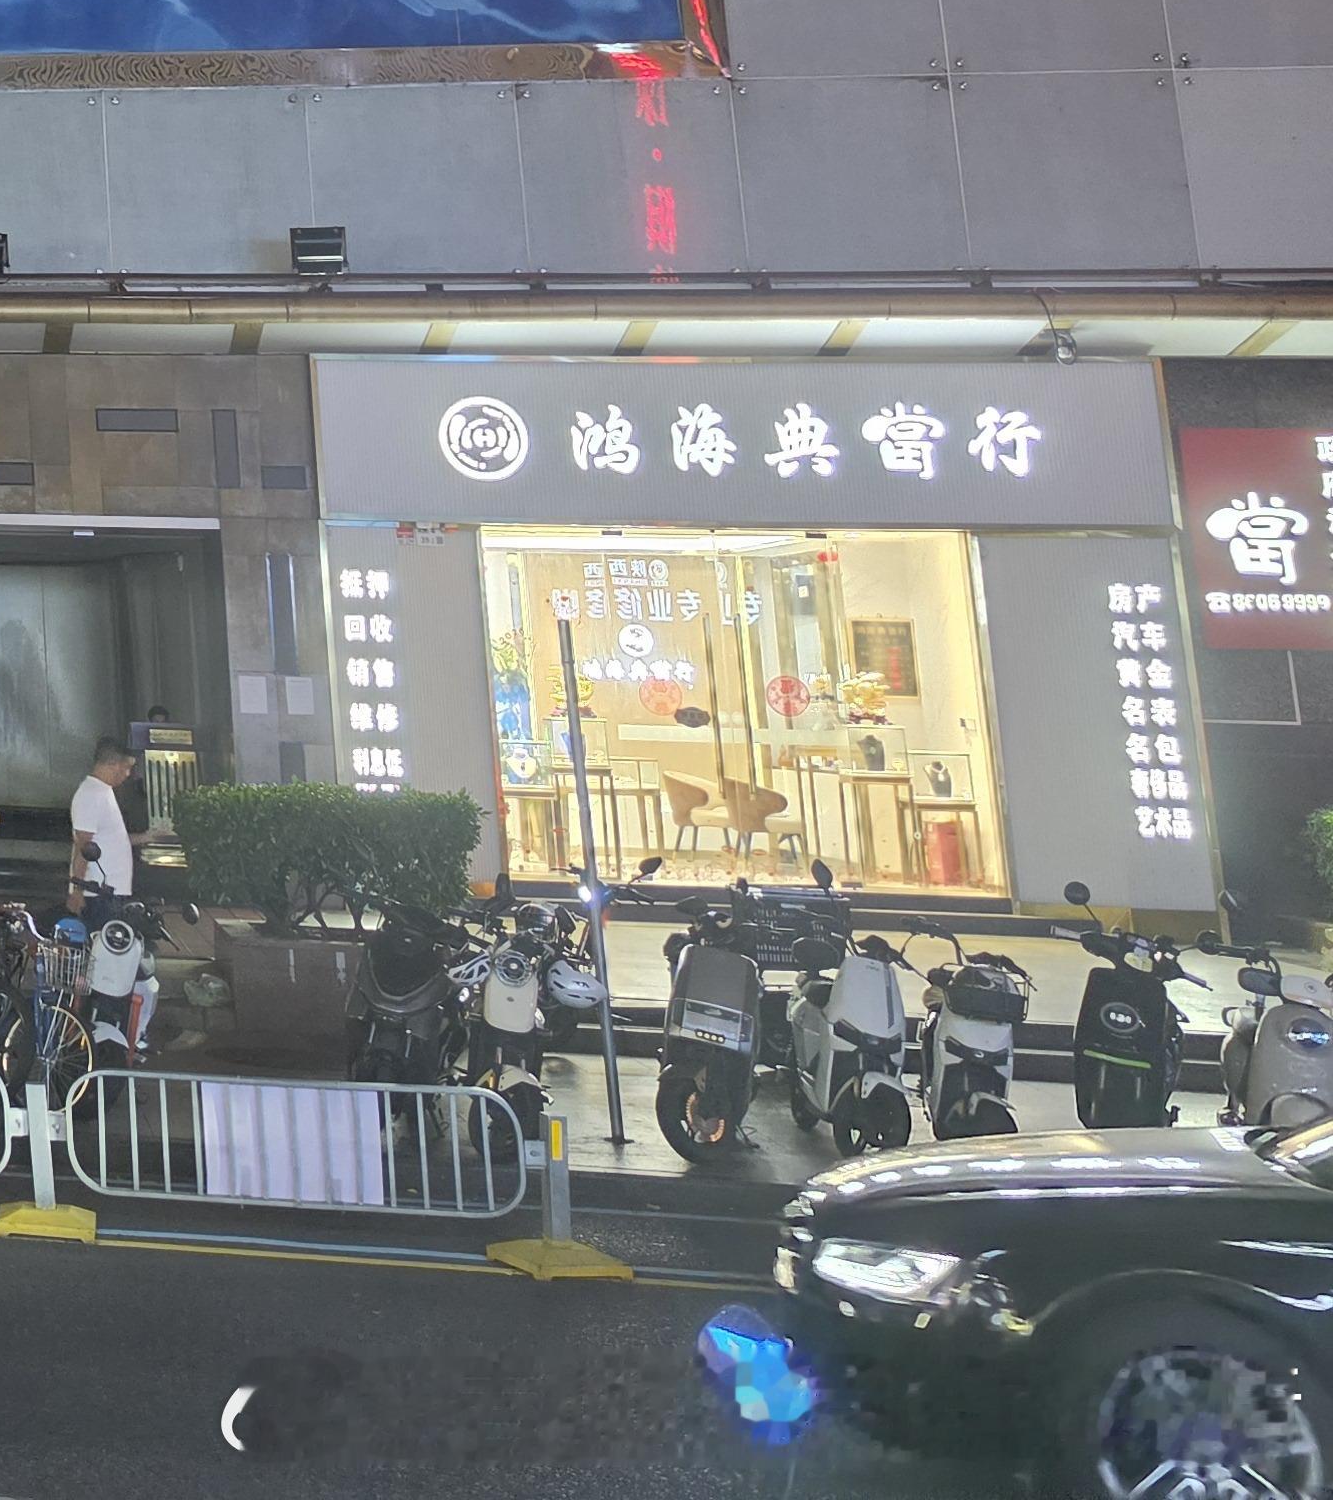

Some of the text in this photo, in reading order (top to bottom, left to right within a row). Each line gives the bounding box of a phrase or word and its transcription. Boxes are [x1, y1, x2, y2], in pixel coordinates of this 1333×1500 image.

[1108, 583, 1162, 614] 房产
[343, 613, 394, 643] 回收
[1111, 621, 1167, 652] 汽车
[1121, 695, 1177, 727] 名表
[1126, 732, 1182, 766] 名包
[1134, 805, 1193, 839] 艺术品
